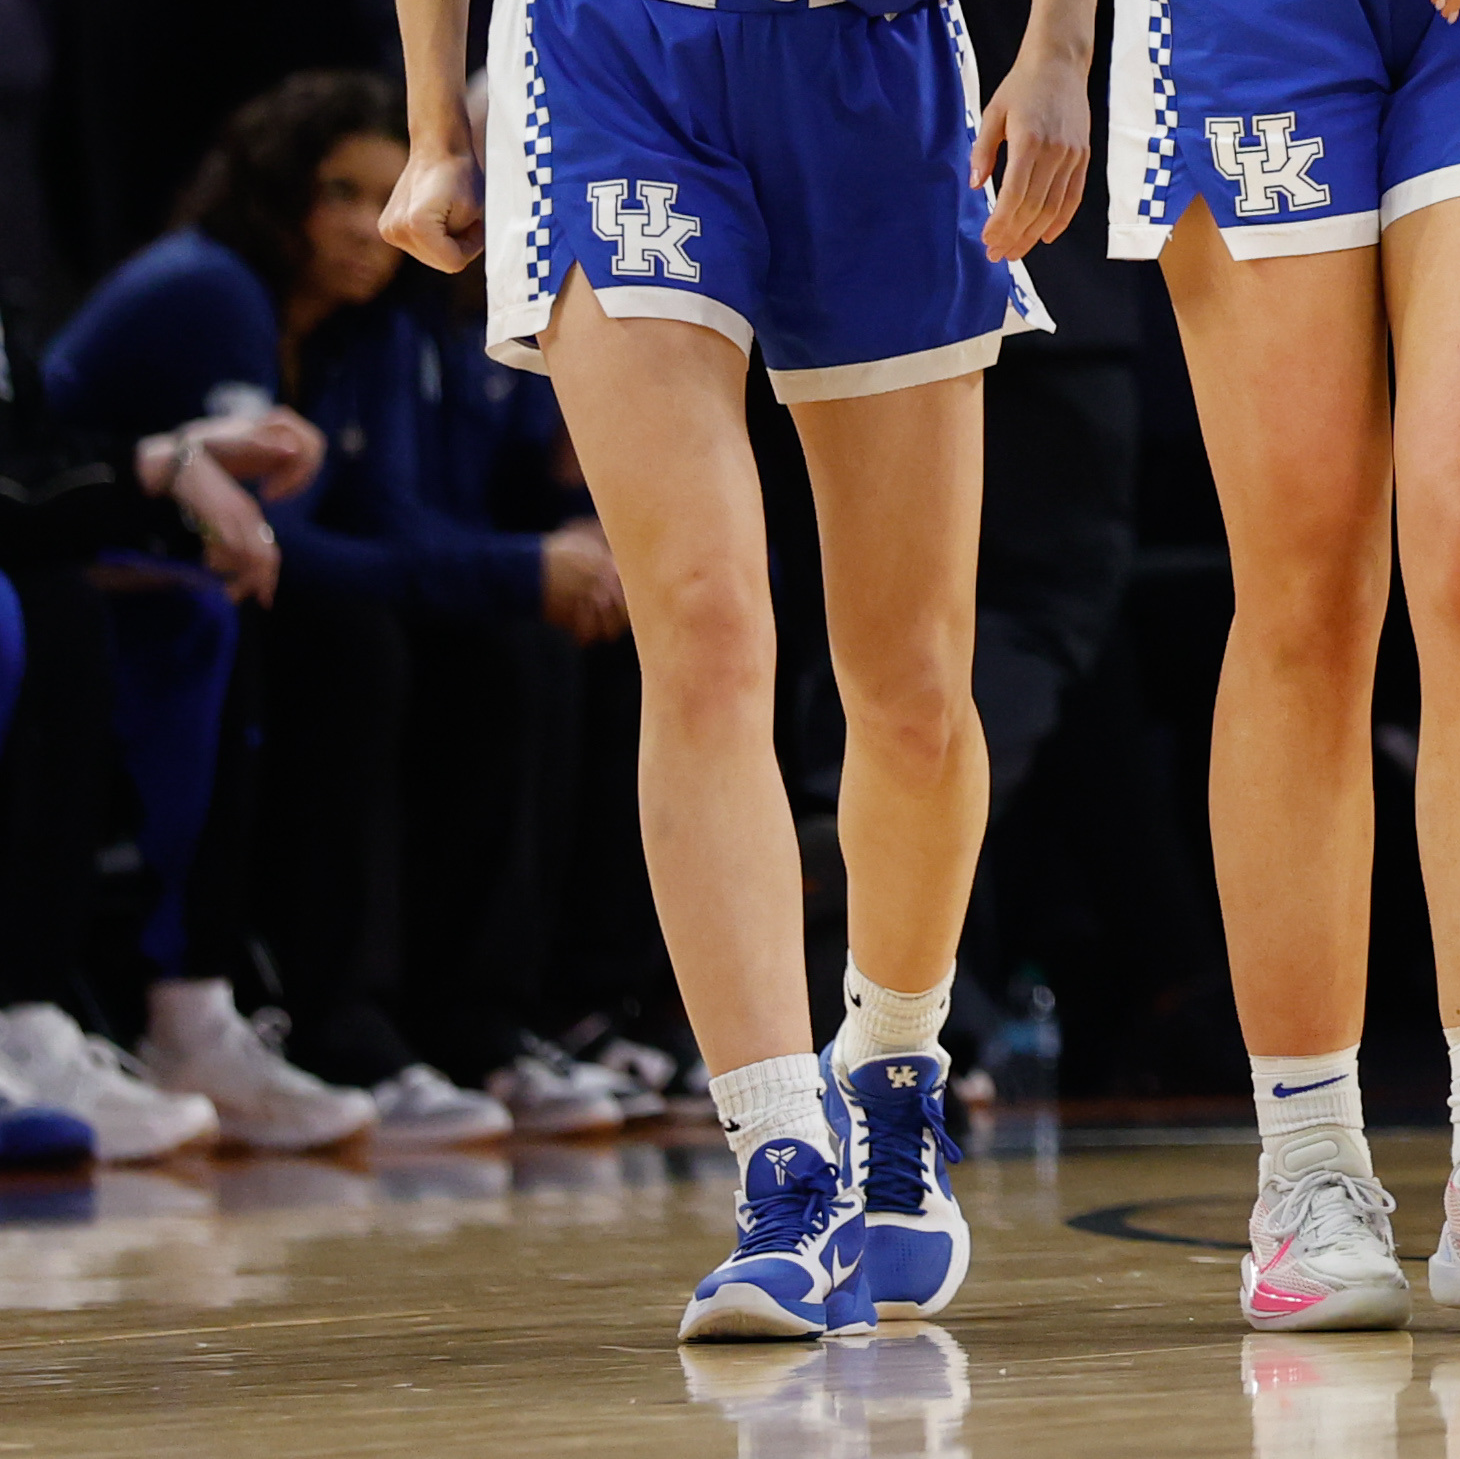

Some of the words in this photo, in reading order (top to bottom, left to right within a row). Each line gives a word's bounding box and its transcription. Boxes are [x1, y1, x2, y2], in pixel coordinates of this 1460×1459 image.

[1205, 111, 1331, 218] UK
[586, 178, 702, 283] UK
[886, 1065, 919, 1089] UK
